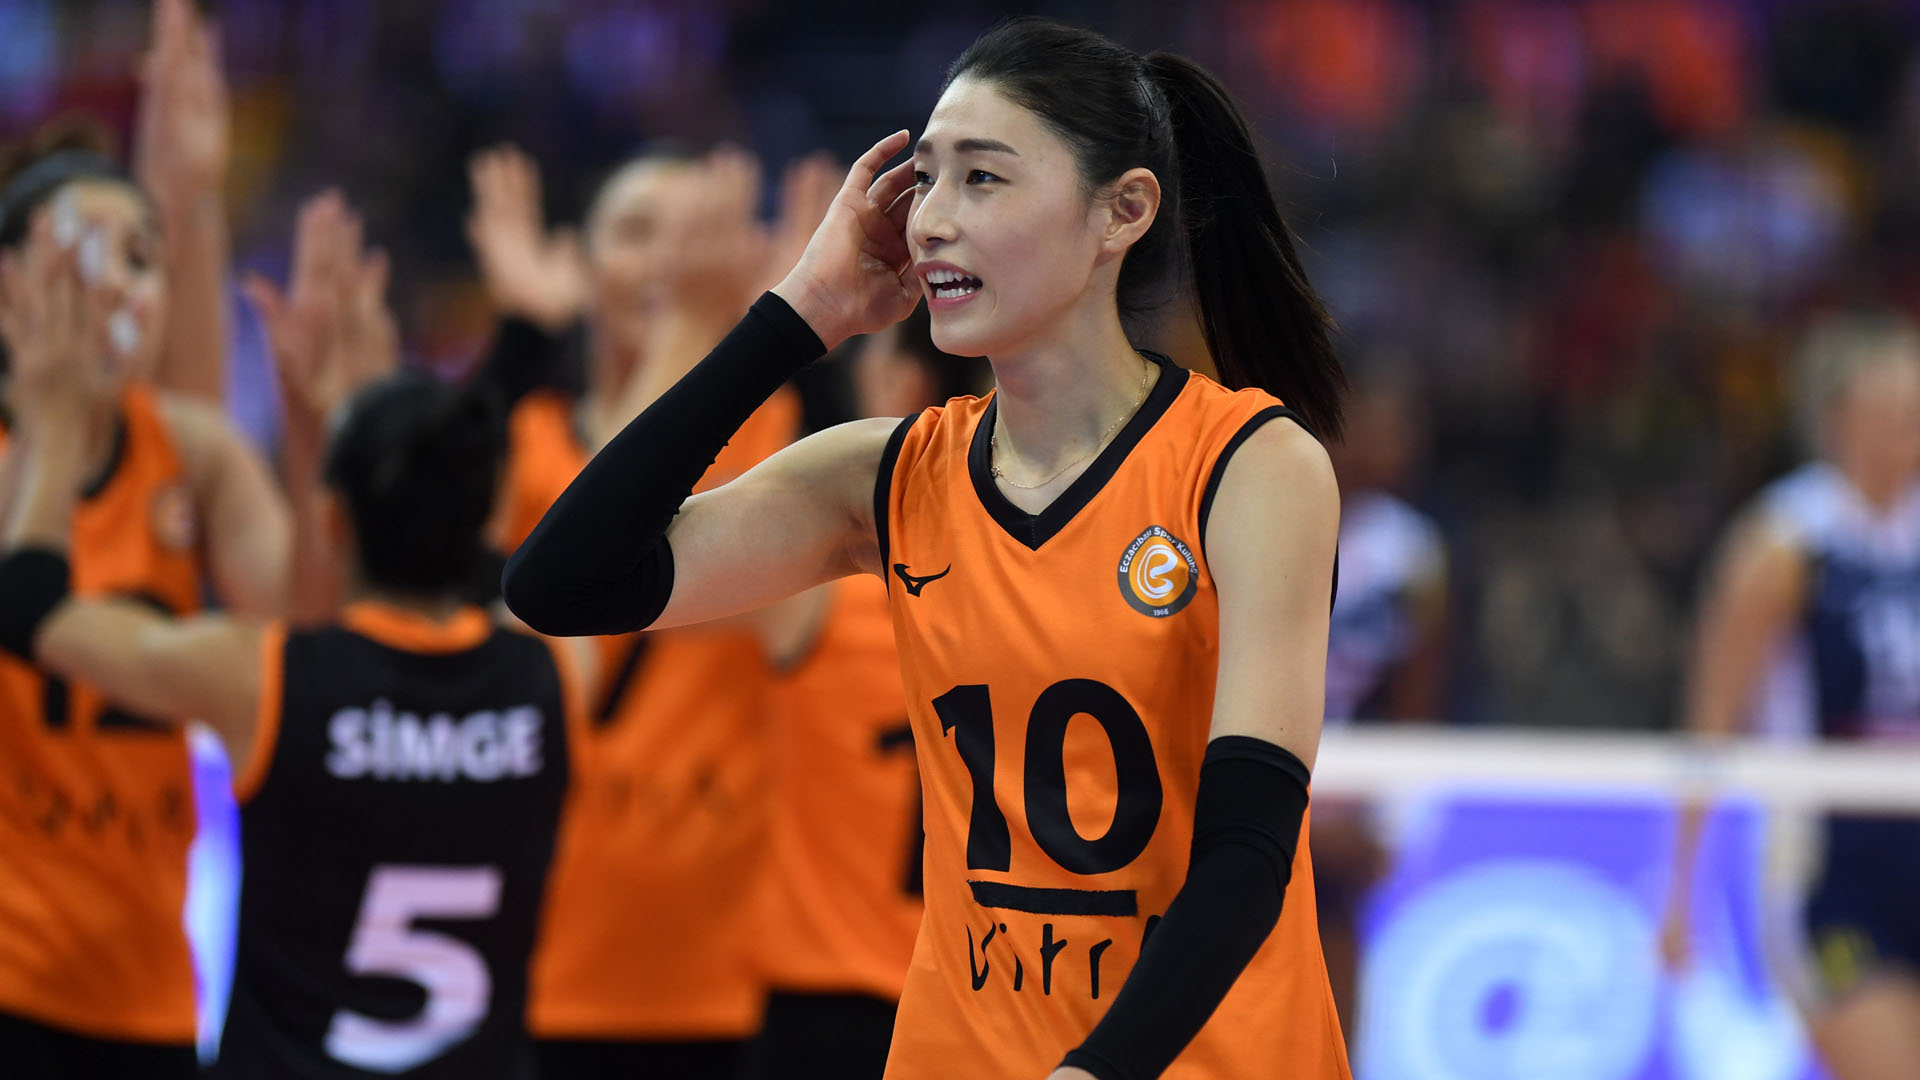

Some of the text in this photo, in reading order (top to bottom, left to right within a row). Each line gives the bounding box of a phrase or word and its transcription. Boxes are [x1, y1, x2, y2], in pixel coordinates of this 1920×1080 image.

[1153, 526, 1176, 545] Spor
[325, 698, 543, 782] SİMGE
[931, 678, 1164, 875] 10
[324, 864, 502, 1073] 5
